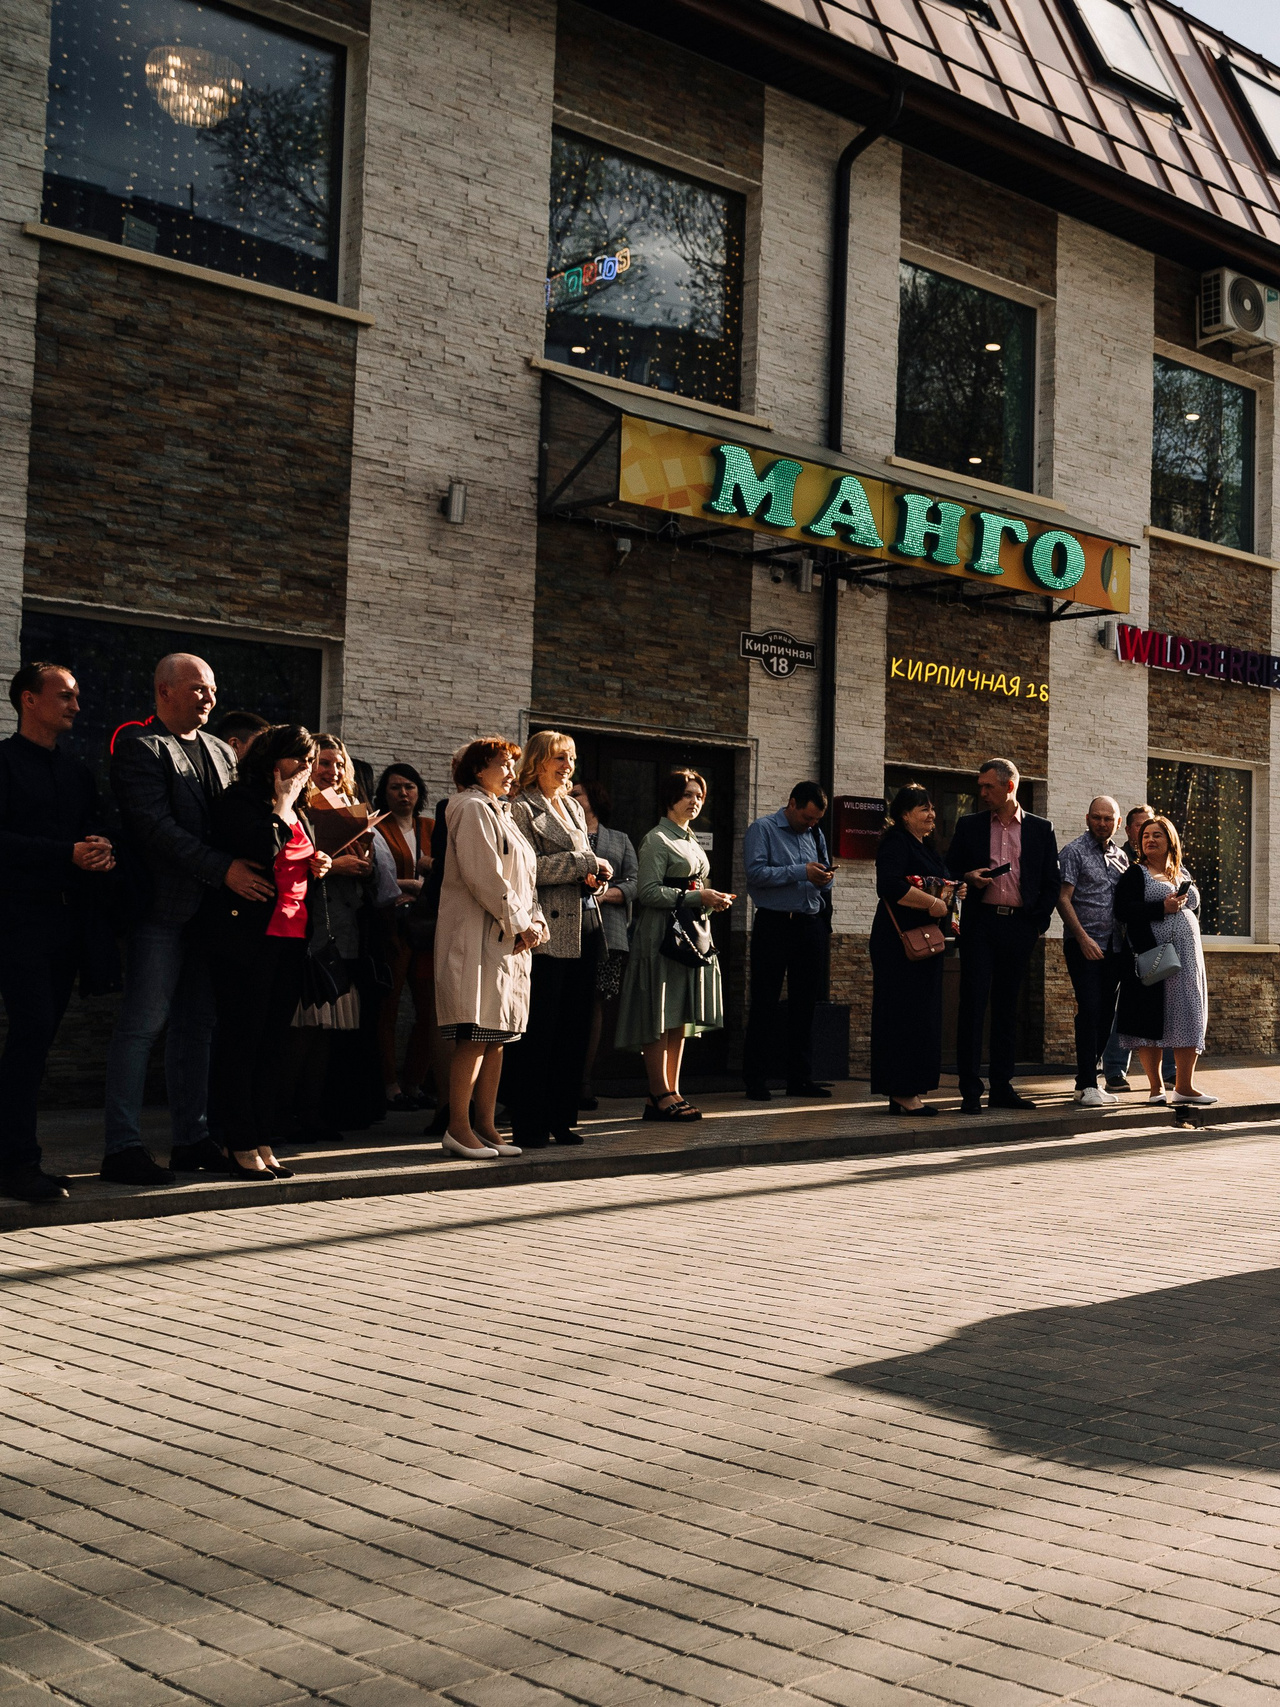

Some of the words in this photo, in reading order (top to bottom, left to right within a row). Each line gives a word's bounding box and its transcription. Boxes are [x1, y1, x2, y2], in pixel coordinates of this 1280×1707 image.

[702, 443, 1086, 591] МАНГО
[745, 638, 813, 661] Кирпичная
[768, 634, 792, 645] улица
[769, 656, 789, 674] 18
[891, 657, 1021, 697] КИРПИЧНАЯ
[1025, 683, 1049, 702] 18
[844, 801, 885, 811] WILDBERRIES
